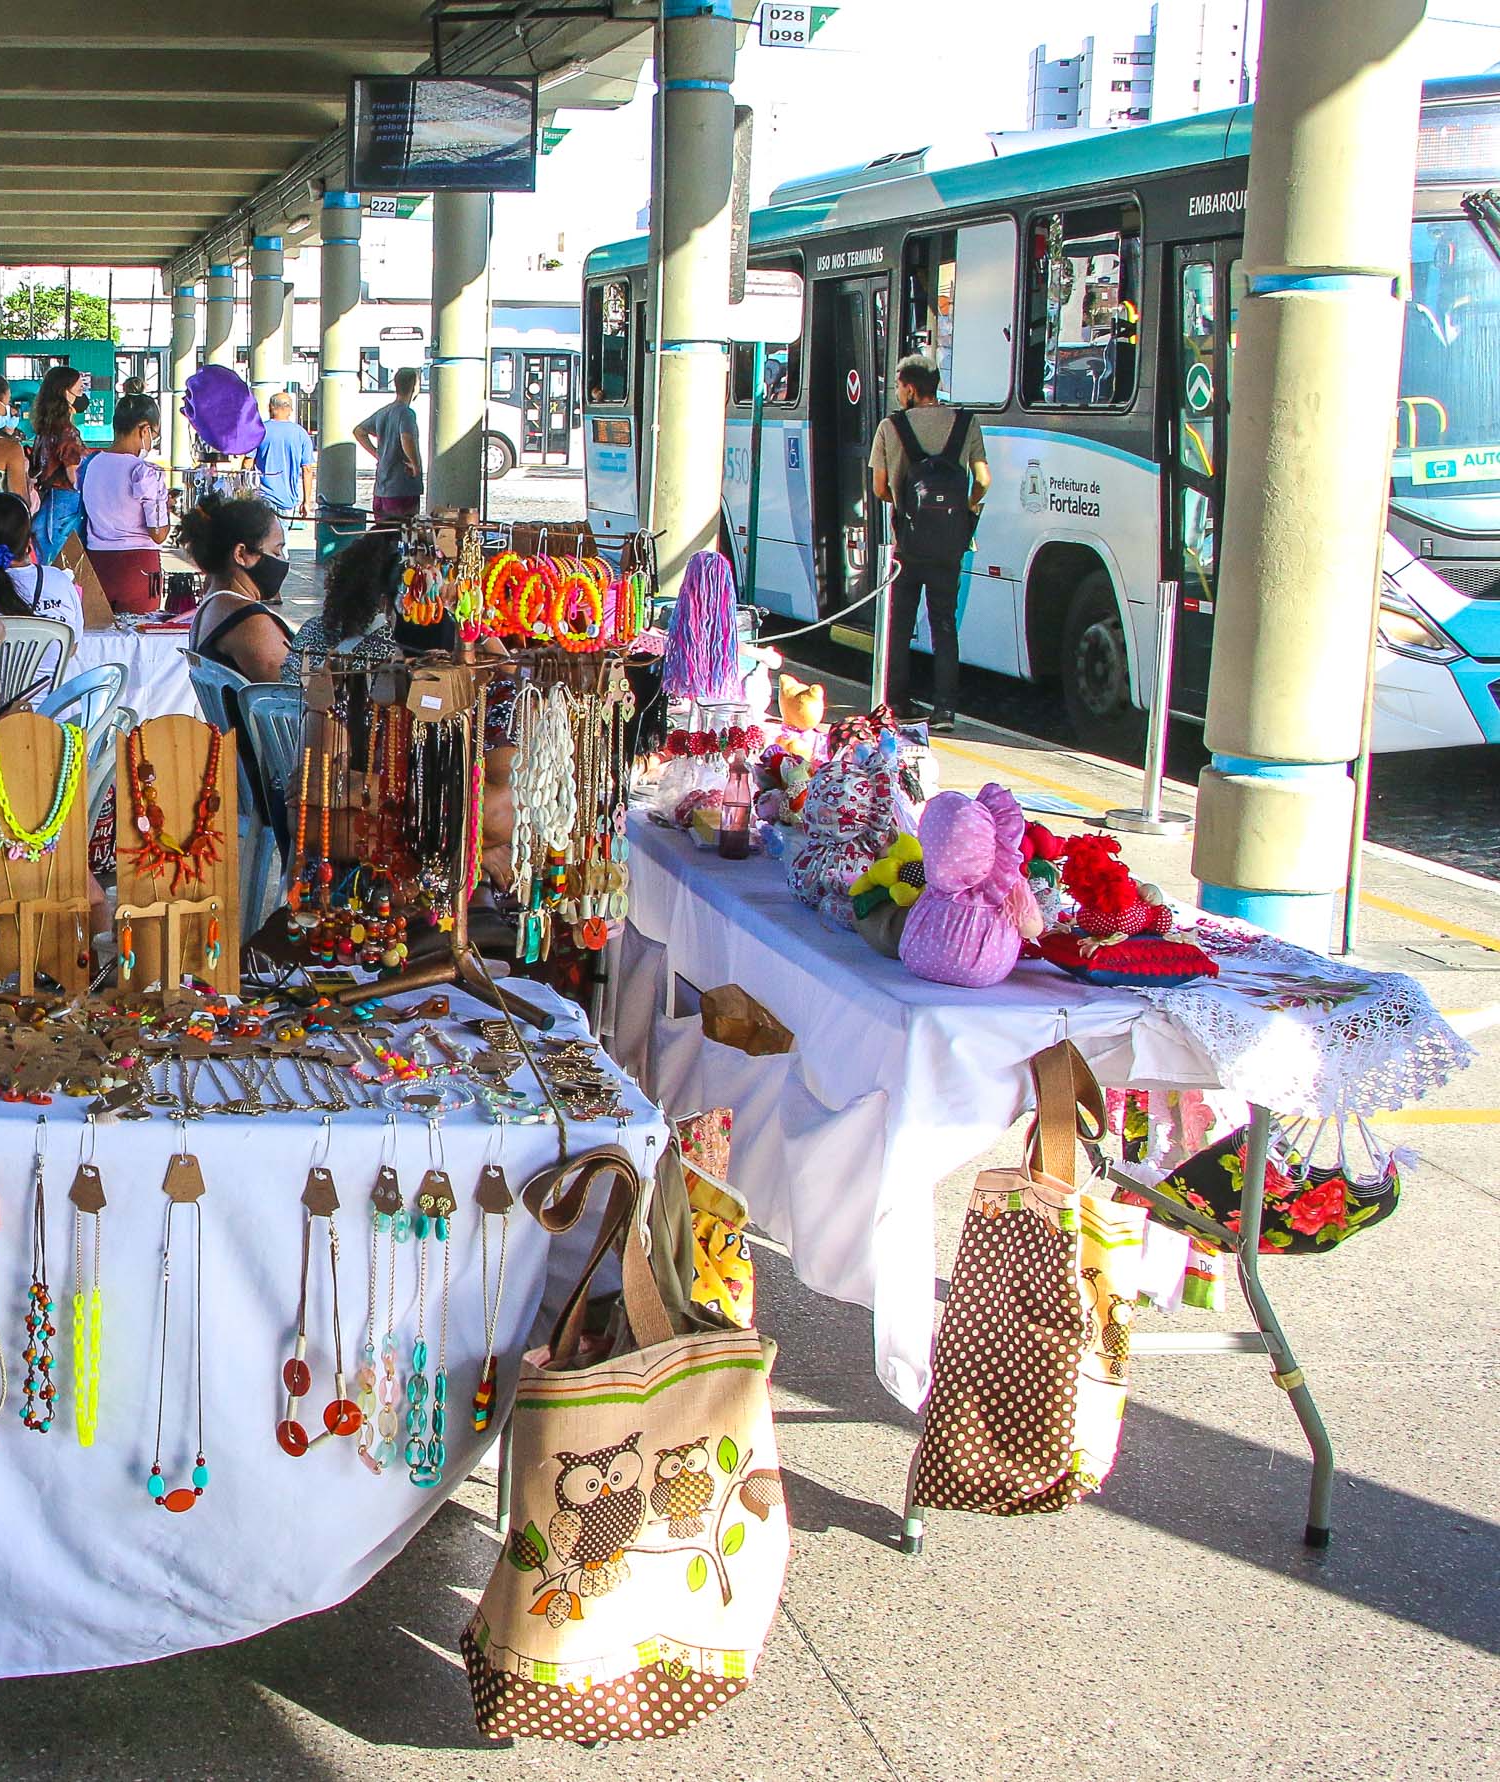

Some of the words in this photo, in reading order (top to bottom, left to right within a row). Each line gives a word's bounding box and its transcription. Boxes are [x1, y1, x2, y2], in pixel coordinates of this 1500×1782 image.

[769, 9, 805, 21] 028
[769, 30, 804, 42] 098
[372, 200, 395, 213] 222
[817, 255, 831, 271] USO
[831, 252, 845, 270] NOS
[847, 246, 884, 267] TERMINAIS
[1049, 477, 1088, 493] Prefeitura
[1090, 480, 1100, 494] de
[1049, 493, 1100, 517] Fortaleza
